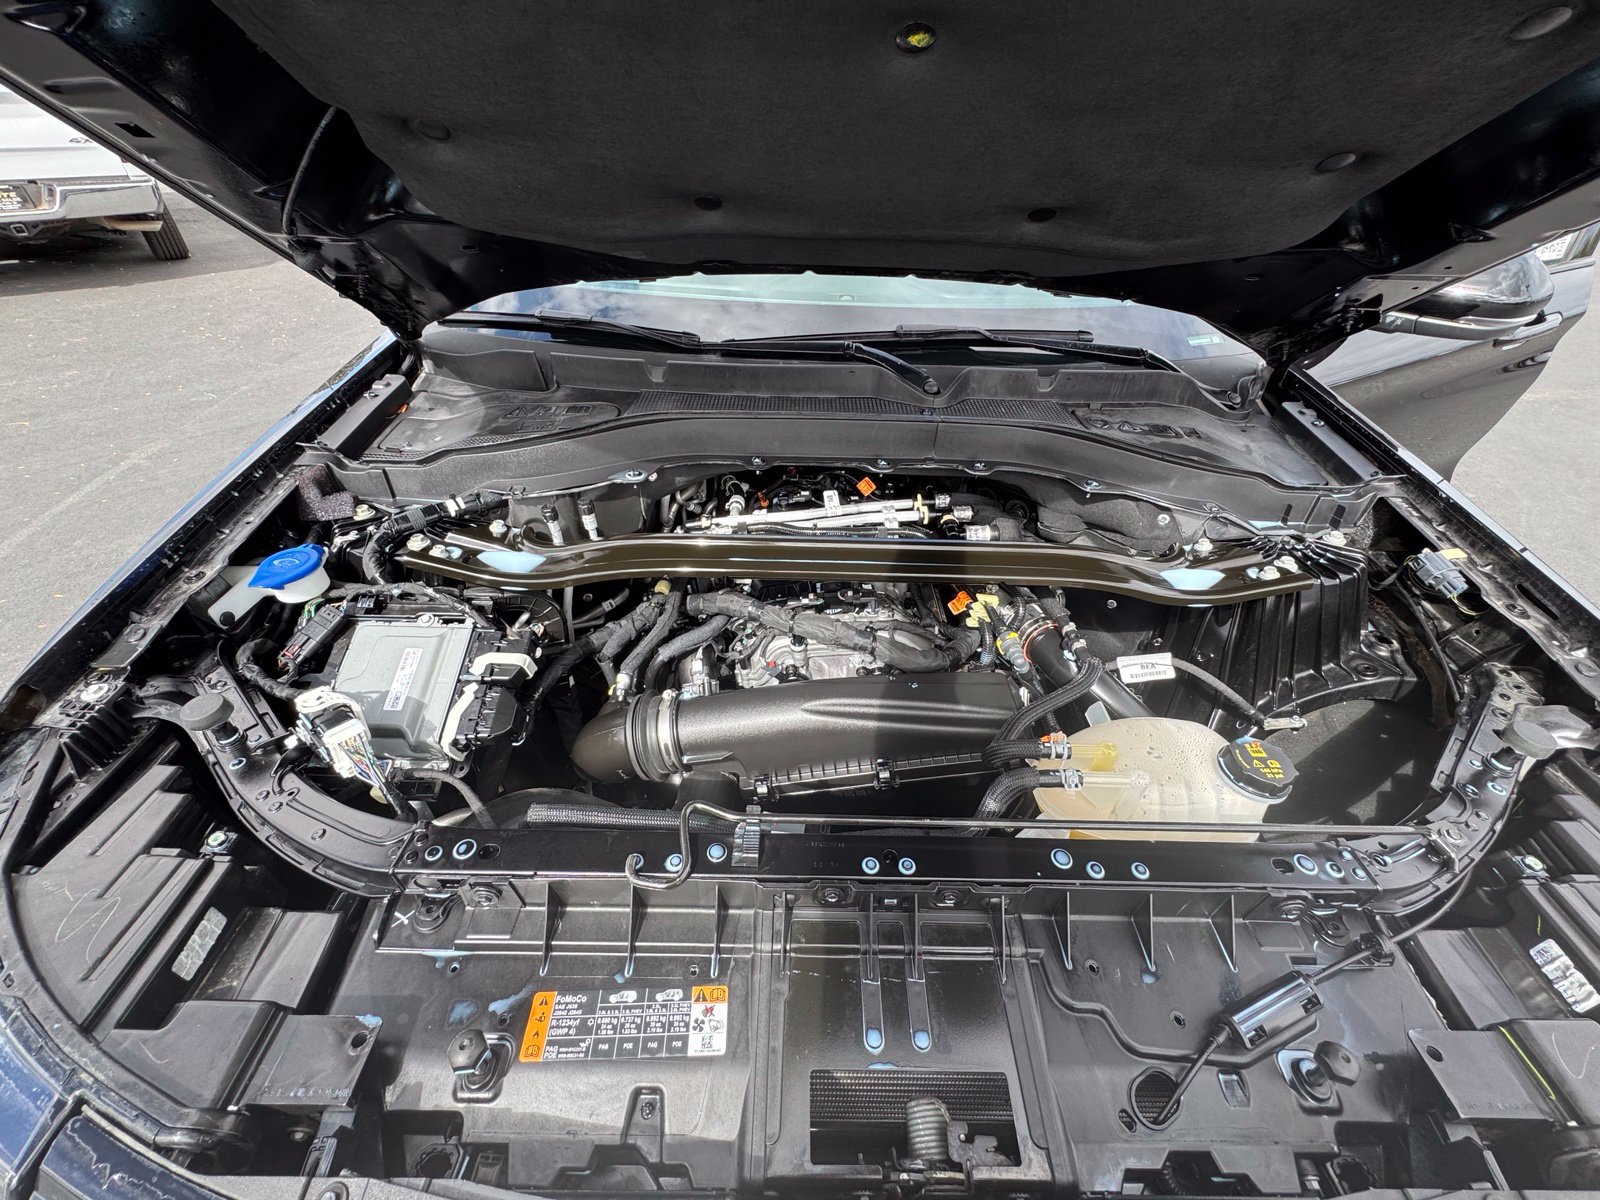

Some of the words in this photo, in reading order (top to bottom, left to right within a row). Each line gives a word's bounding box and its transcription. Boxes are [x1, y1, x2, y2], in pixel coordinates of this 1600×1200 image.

[556, 995, 587, 1003] FoMoCo
[551, 1018, 580, 1027] R-1234yf
[549, 1028, 568, 1036] (GWP
[569, 1028, 576, 1036] 4)
